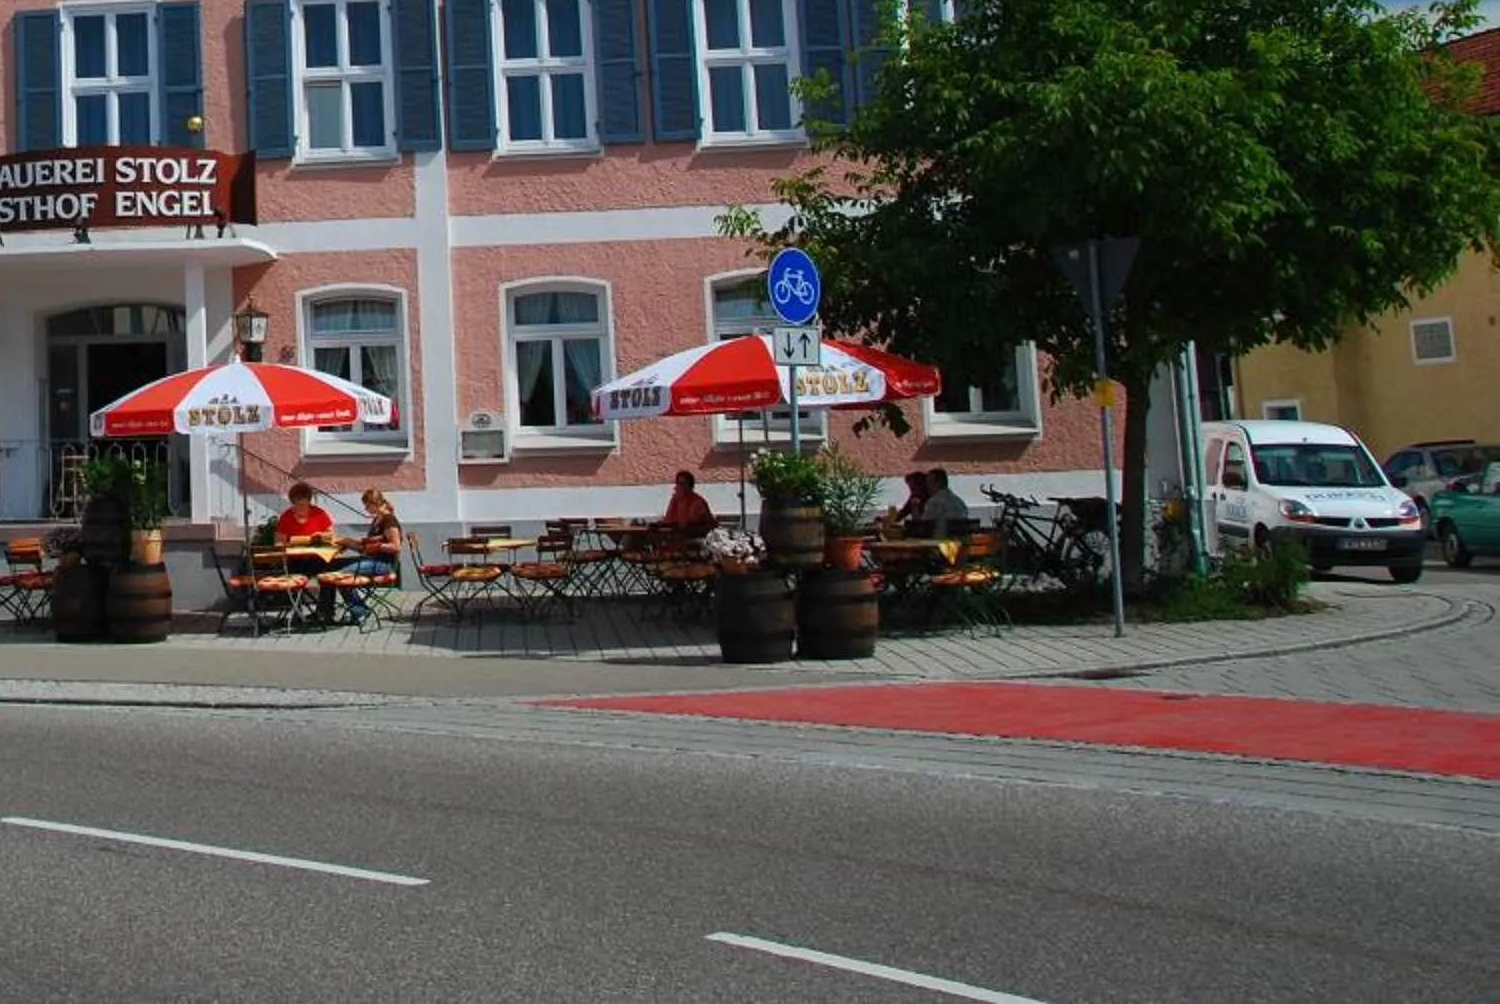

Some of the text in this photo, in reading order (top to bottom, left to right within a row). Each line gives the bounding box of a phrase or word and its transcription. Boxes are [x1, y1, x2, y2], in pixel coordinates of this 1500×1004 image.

[115, 156, 217, 184] STOLZ
[115, 190, 214, 217] ENGEL
[795, 371, 868, 396] STOLZ
[609, 385, 662, 410] STOLZ
[188, 404, 260, 427] STOLZ
